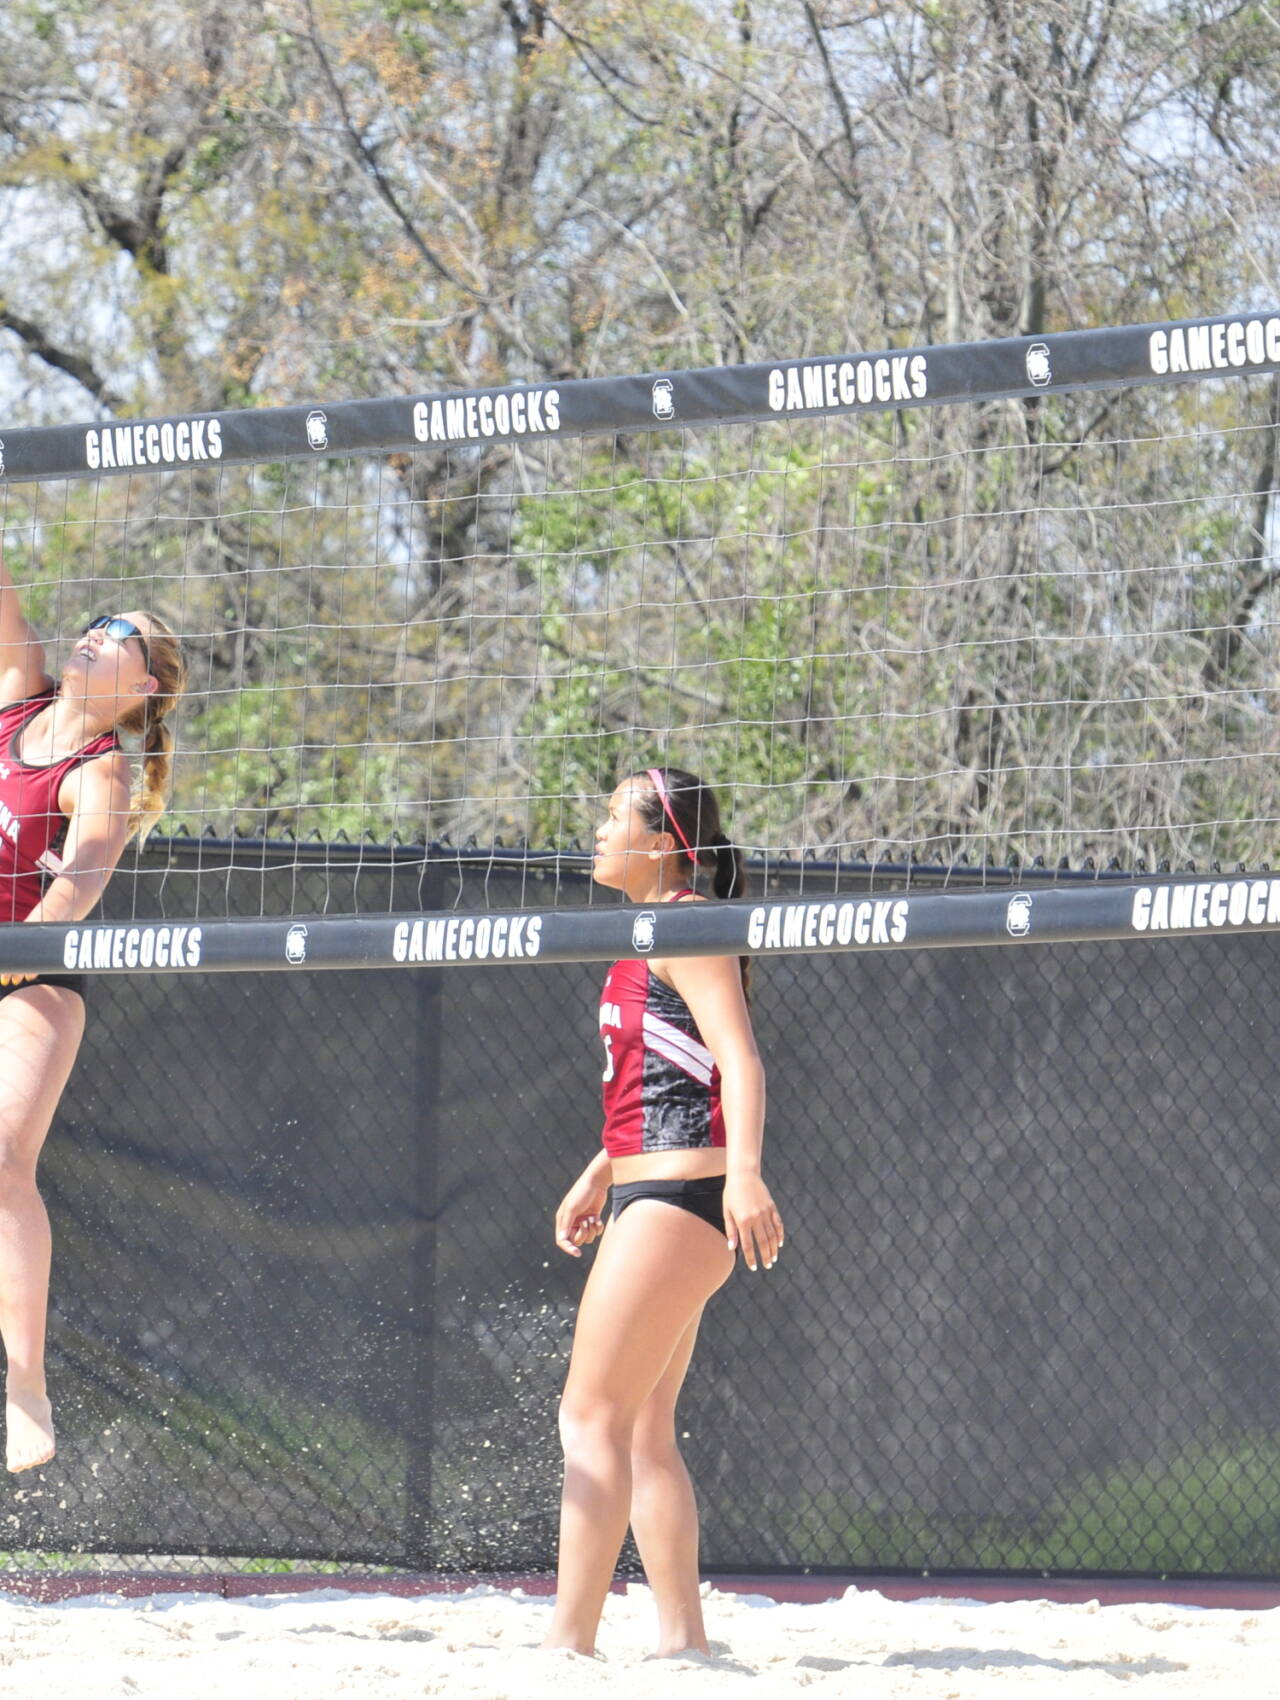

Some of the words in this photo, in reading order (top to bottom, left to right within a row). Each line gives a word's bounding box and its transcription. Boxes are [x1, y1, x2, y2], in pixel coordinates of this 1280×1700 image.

[85, 419, 223, 469] GAMECOCKS
[413, 389, 561, 442] GAMECOCKS
[768, 354, 927, 411] GAMECOCKS
[63, 926, 202, 970] GAMECOCKS
[392, 915, 543, 962] GAMECOCKS
[747, 899, 909, 949] GAMECOCKS
